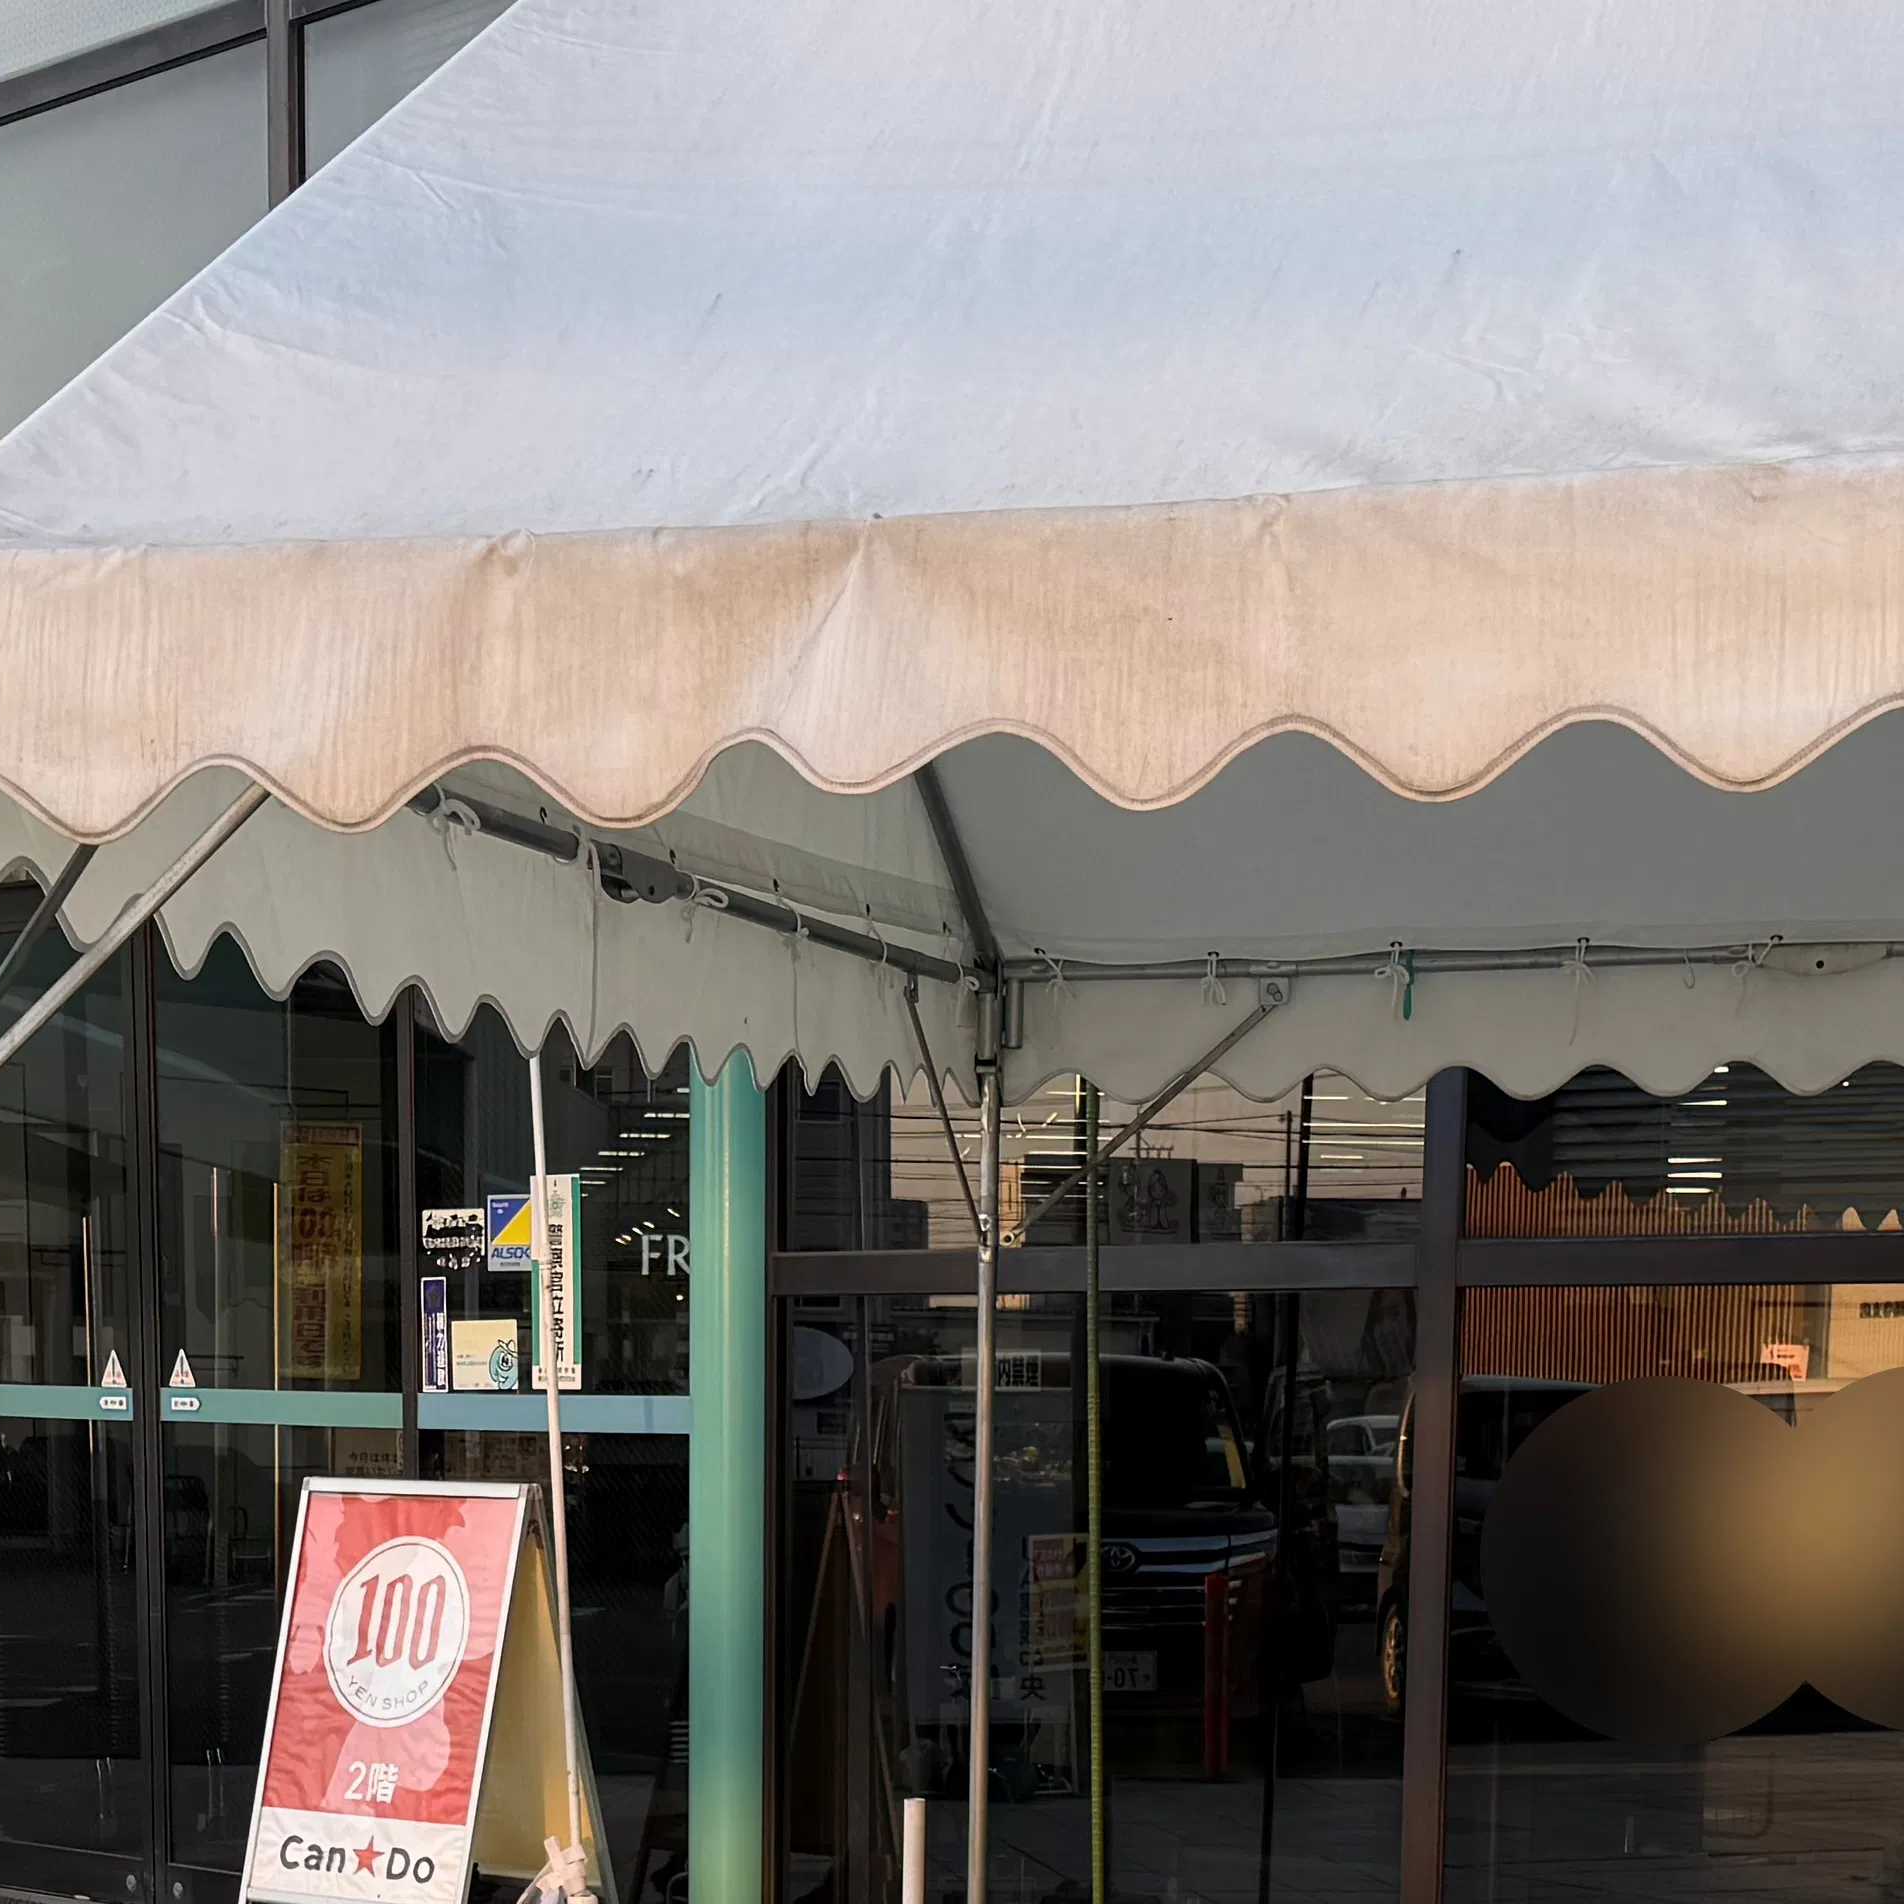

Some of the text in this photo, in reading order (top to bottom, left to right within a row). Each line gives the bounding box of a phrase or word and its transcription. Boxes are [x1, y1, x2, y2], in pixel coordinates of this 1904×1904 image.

[491, 1247, 532, 1260] ALSOK
[345, 1574, 447, 1671] 100
[348, 1675, 431, 1711] YEN SHOP
[343, 1760, 400, 1805] 2階
[279, 1834, 436, 1884] Can Do
